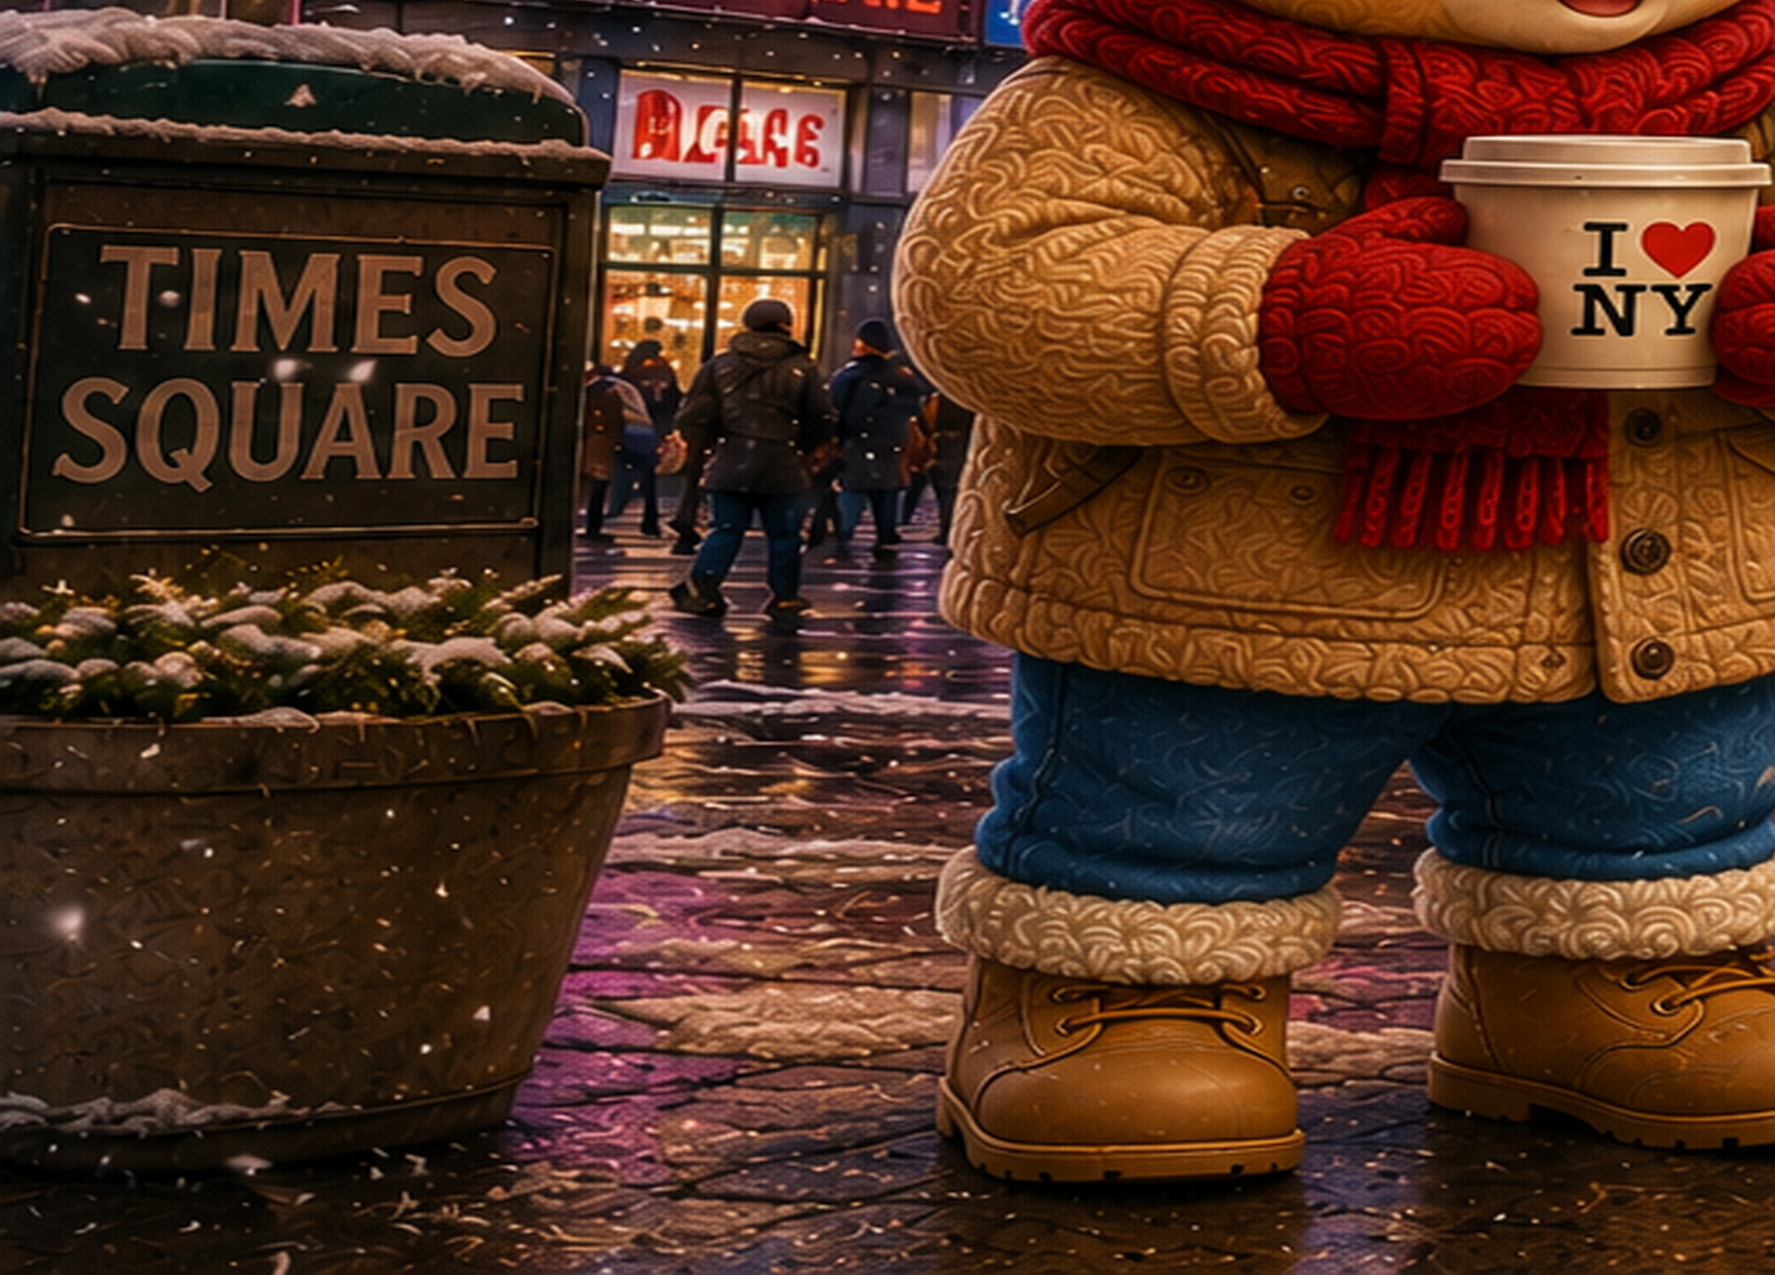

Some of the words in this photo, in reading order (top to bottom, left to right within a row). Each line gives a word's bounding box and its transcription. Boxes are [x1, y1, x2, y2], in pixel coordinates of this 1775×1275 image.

[1583, 222, 1629, 277] I
[101, 245, 498, 357] TIMES
[1571, 283, 1714, 337] NY
[52, 377, 525, 493] SQUARE
